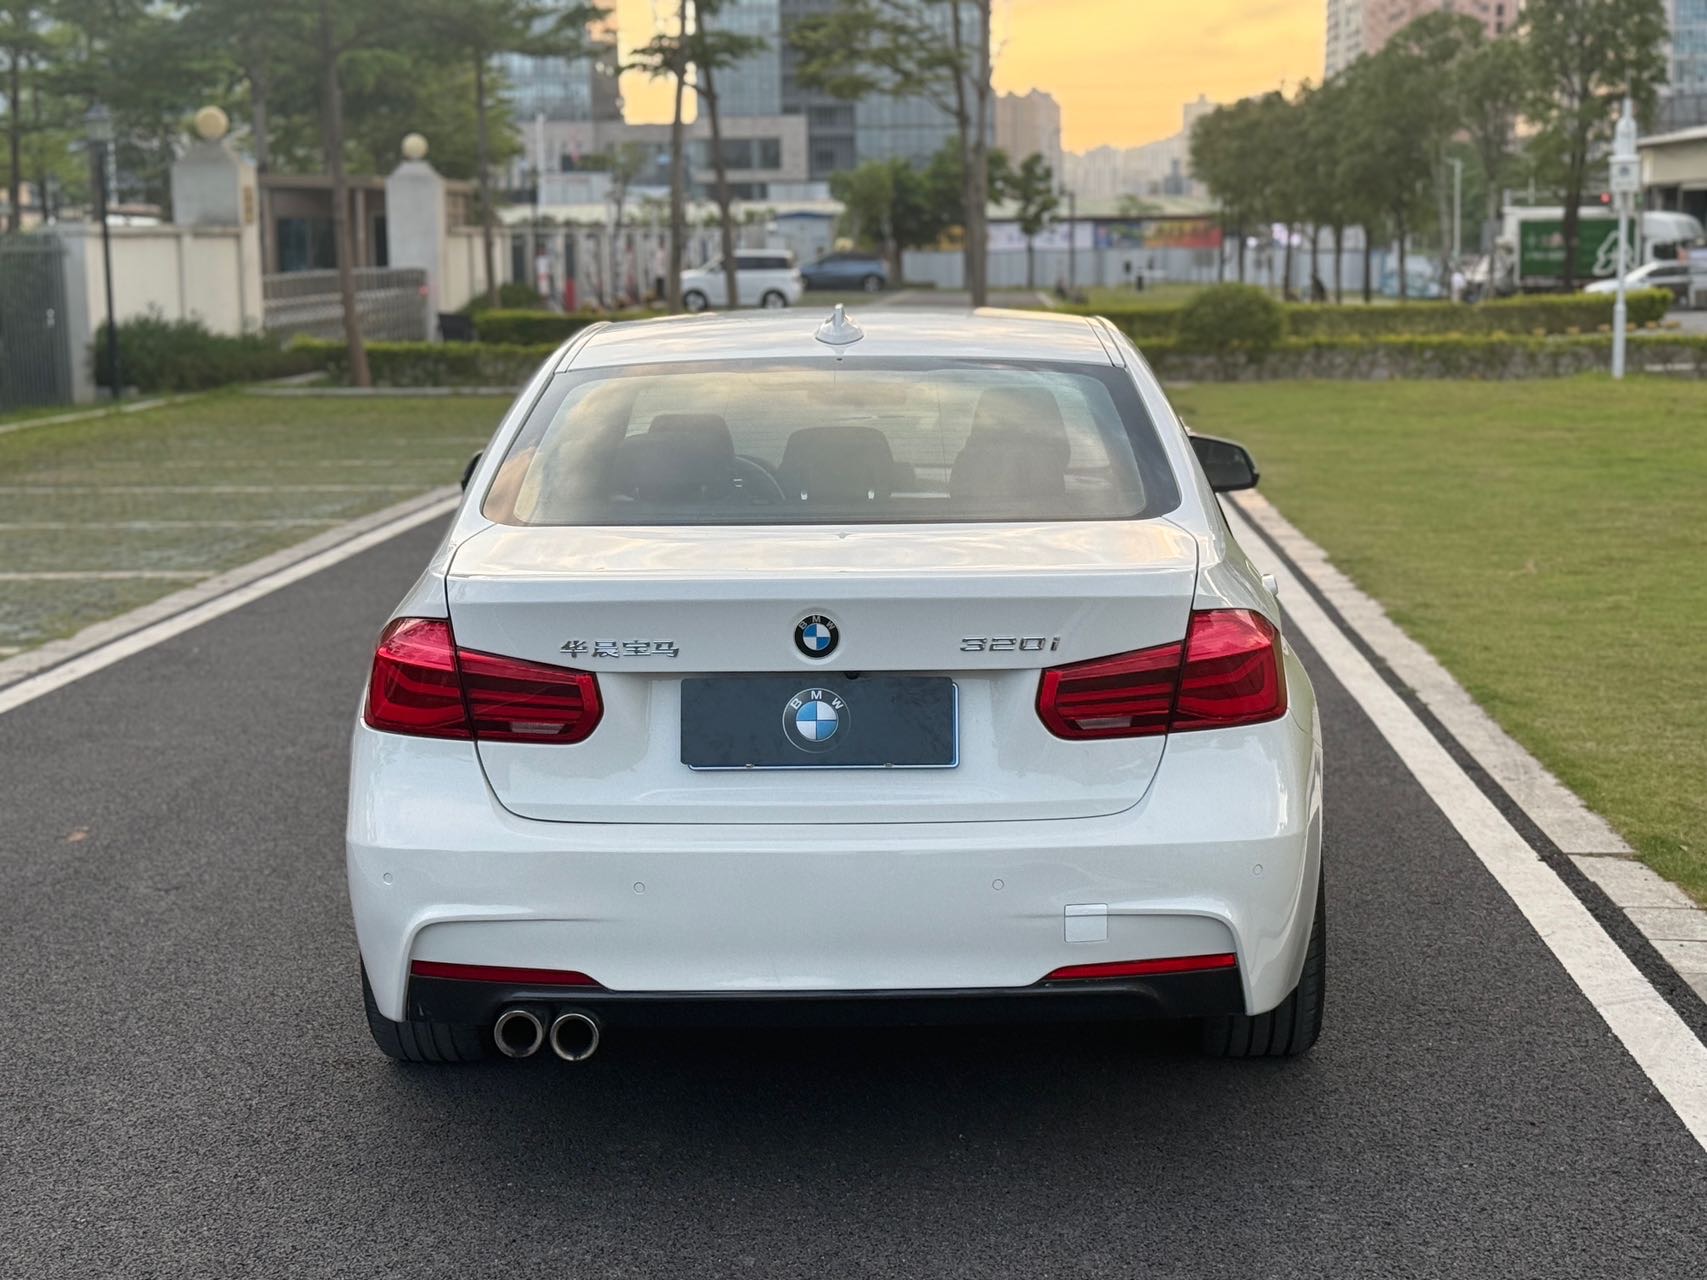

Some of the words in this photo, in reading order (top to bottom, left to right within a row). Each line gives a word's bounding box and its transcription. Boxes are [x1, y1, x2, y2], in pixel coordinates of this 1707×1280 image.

[798, 615, 836, 630] BMW
[559, 640, 680, 658] 华晨宝马
[960, 636, 1060, 651] 320i
[790, 690, 844, 710] BMW
